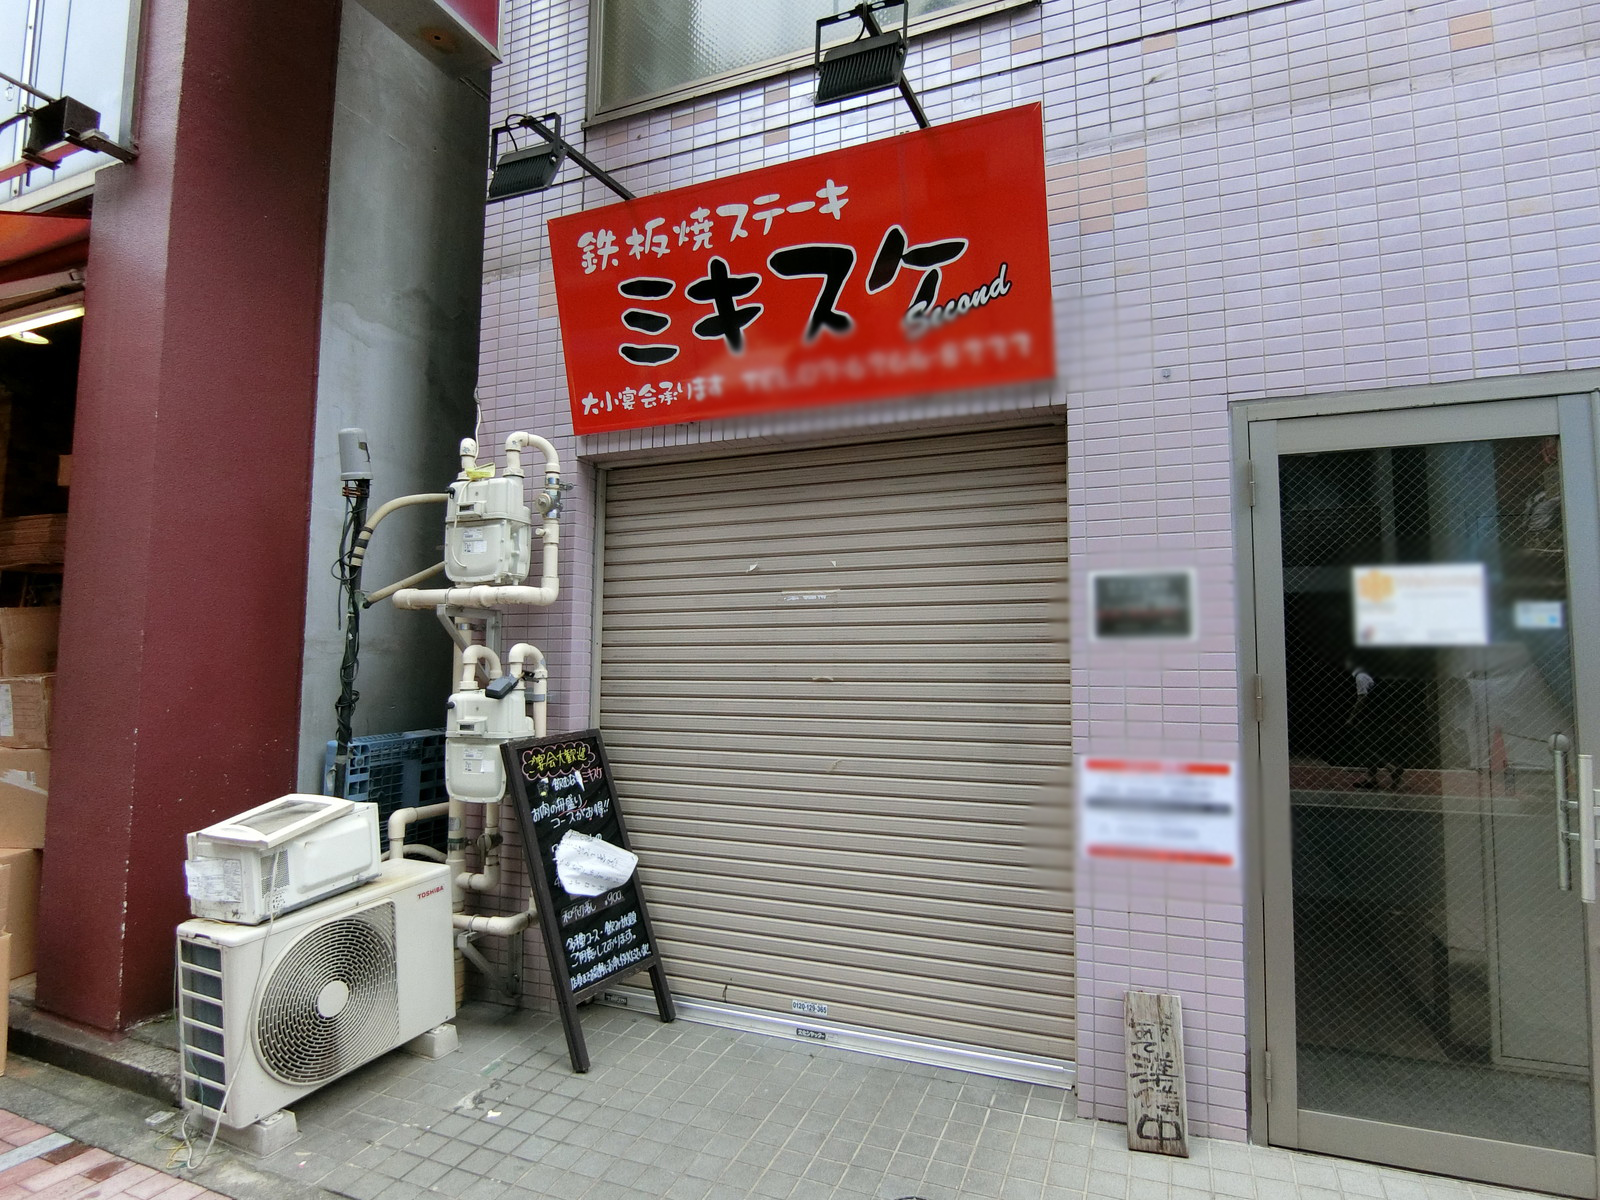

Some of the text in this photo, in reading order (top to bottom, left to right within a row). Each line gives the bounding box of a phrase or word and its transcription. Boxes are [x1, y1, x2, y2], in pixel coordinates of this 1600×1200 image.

[577, 179, 849, 274] 鉄板焼ステーキ
[618, 224, 969, 367] ミキスケ
[903, 262, 1012, 340] Second
[417, 885, 444, 899] TOSHIBA
[792, 1001, 827, 1014] 0120-129-365
